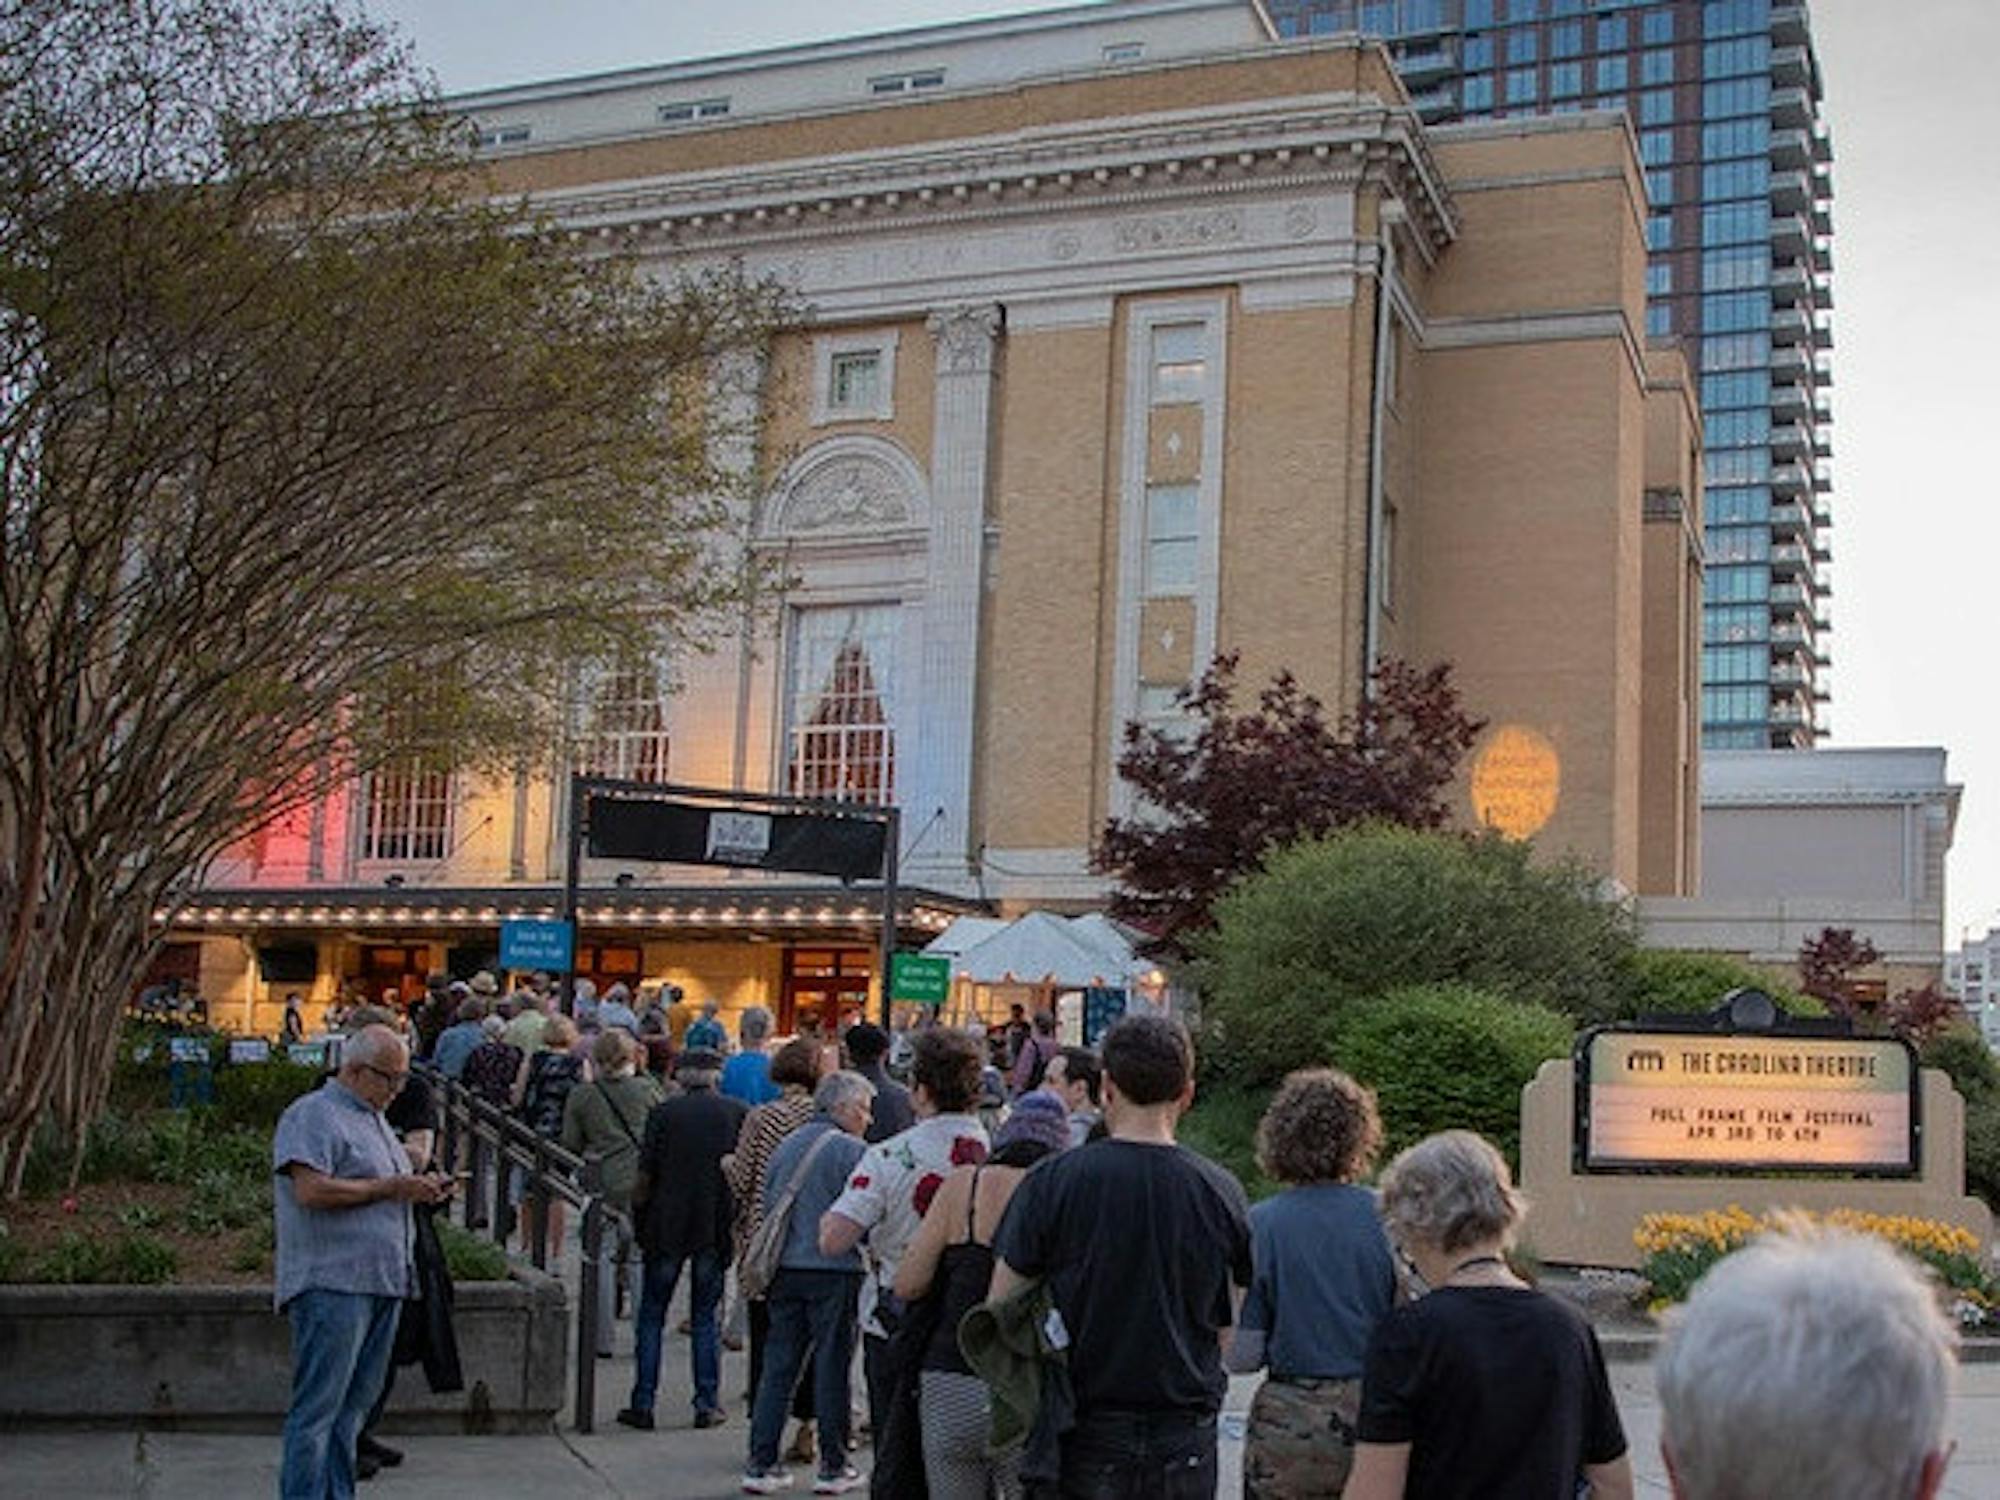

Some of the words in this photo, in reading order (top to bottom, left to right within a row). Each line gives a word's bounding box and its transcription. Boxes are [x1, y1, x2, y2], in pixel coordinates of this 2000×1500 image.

[1682, 1052, 1711, 1074] THE
[1716, 1052, 1799, 1075] CAROLINA
[1806, 1055, 1878, 1078] THEATRE
[1650, 1107, 1685, 1123] FULL
[1698, 1107, 1746, 1123] FRAME
[1758, 1109, 1792, 1124] FILM
[1804, 1110, 1873, 1128] FESTIVAL
[1687, 1125, 1715, 1139] APR
[1727, 1126, 1753, 1141] 3RD
[1766, 1127, 1785, 1141] TO
